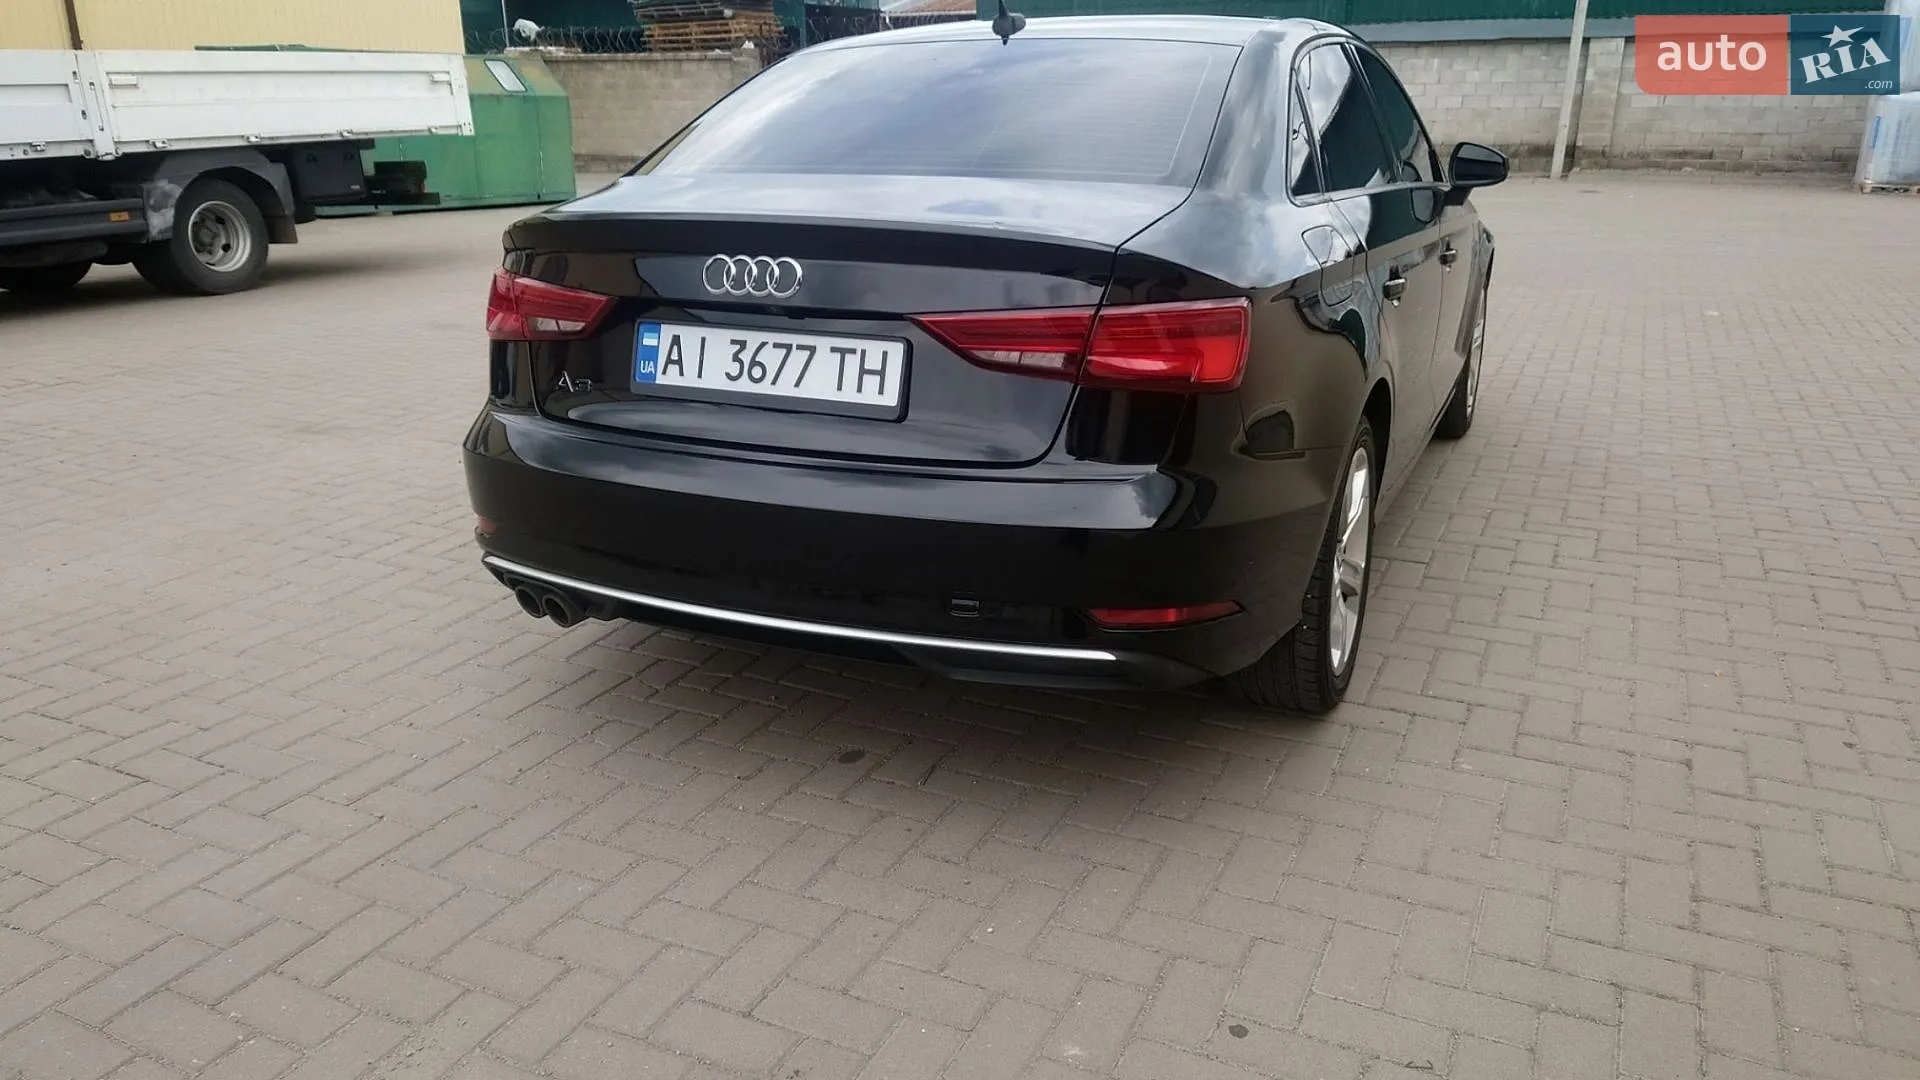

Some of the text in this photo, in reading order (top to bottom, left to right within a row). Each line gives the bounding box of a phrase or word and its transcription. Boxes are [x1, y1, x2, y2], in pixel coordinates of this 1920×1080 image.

[640, 361, 655, 374] UA
[724, 338, 817, 388] 3677
[830, 346, 889, 395] TH
